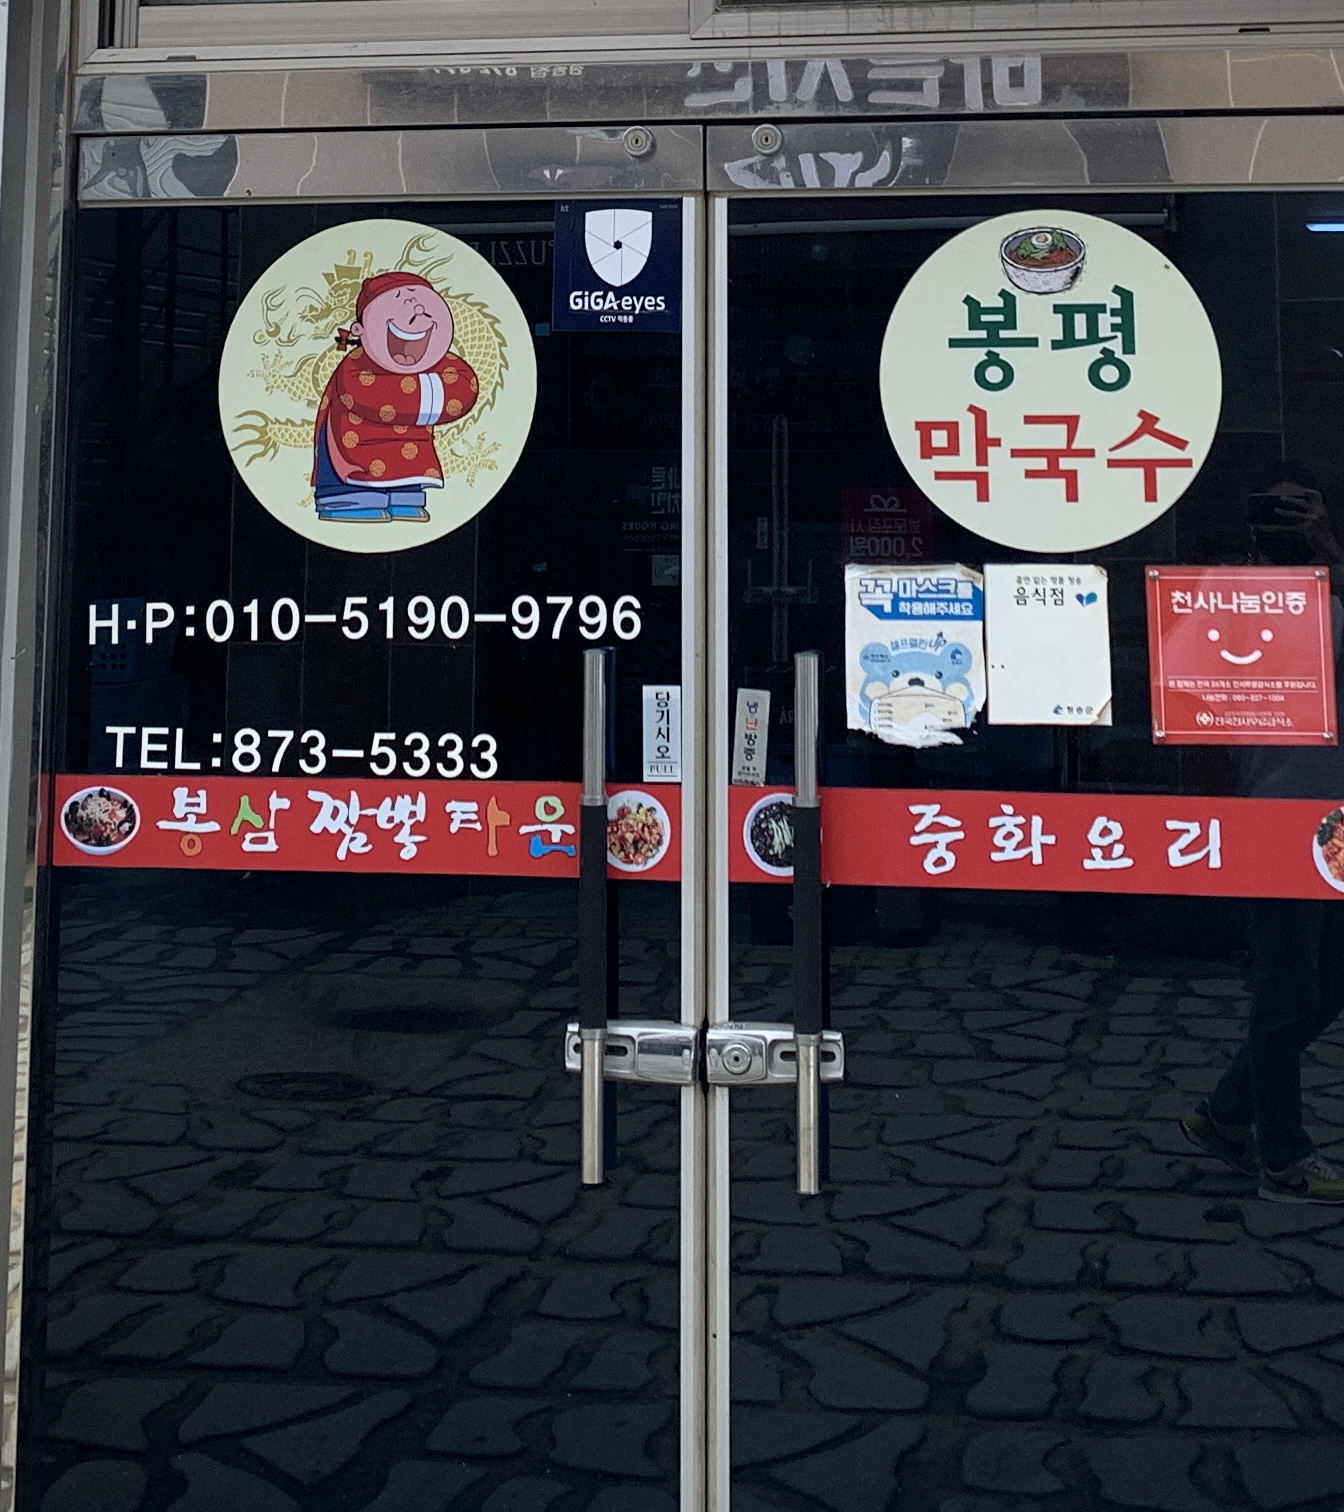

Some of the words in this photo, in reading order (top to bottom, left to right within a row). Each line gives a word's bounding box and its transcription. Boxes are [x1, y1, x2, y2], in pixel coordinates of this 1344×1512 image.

[599, 315, 616, 323] CCTV
[947, 284, 1137, 392] 봉평
[914, 403, 1193, 503] 막국수
[858, 577, 893, 613] 꼭
[897, 577, 974, 599] 마스크를
[898, 602, 974, 616] 착용해주세요
[1013, 586, 1064, 606] 음식점
[1171, 590, 1307, 615] 천사나눔인증
[655, 690, 671, 759] 당기시오
[105, 726, 499, 780] TEL:873-5333
[649, 764, 676, 774] PULL
